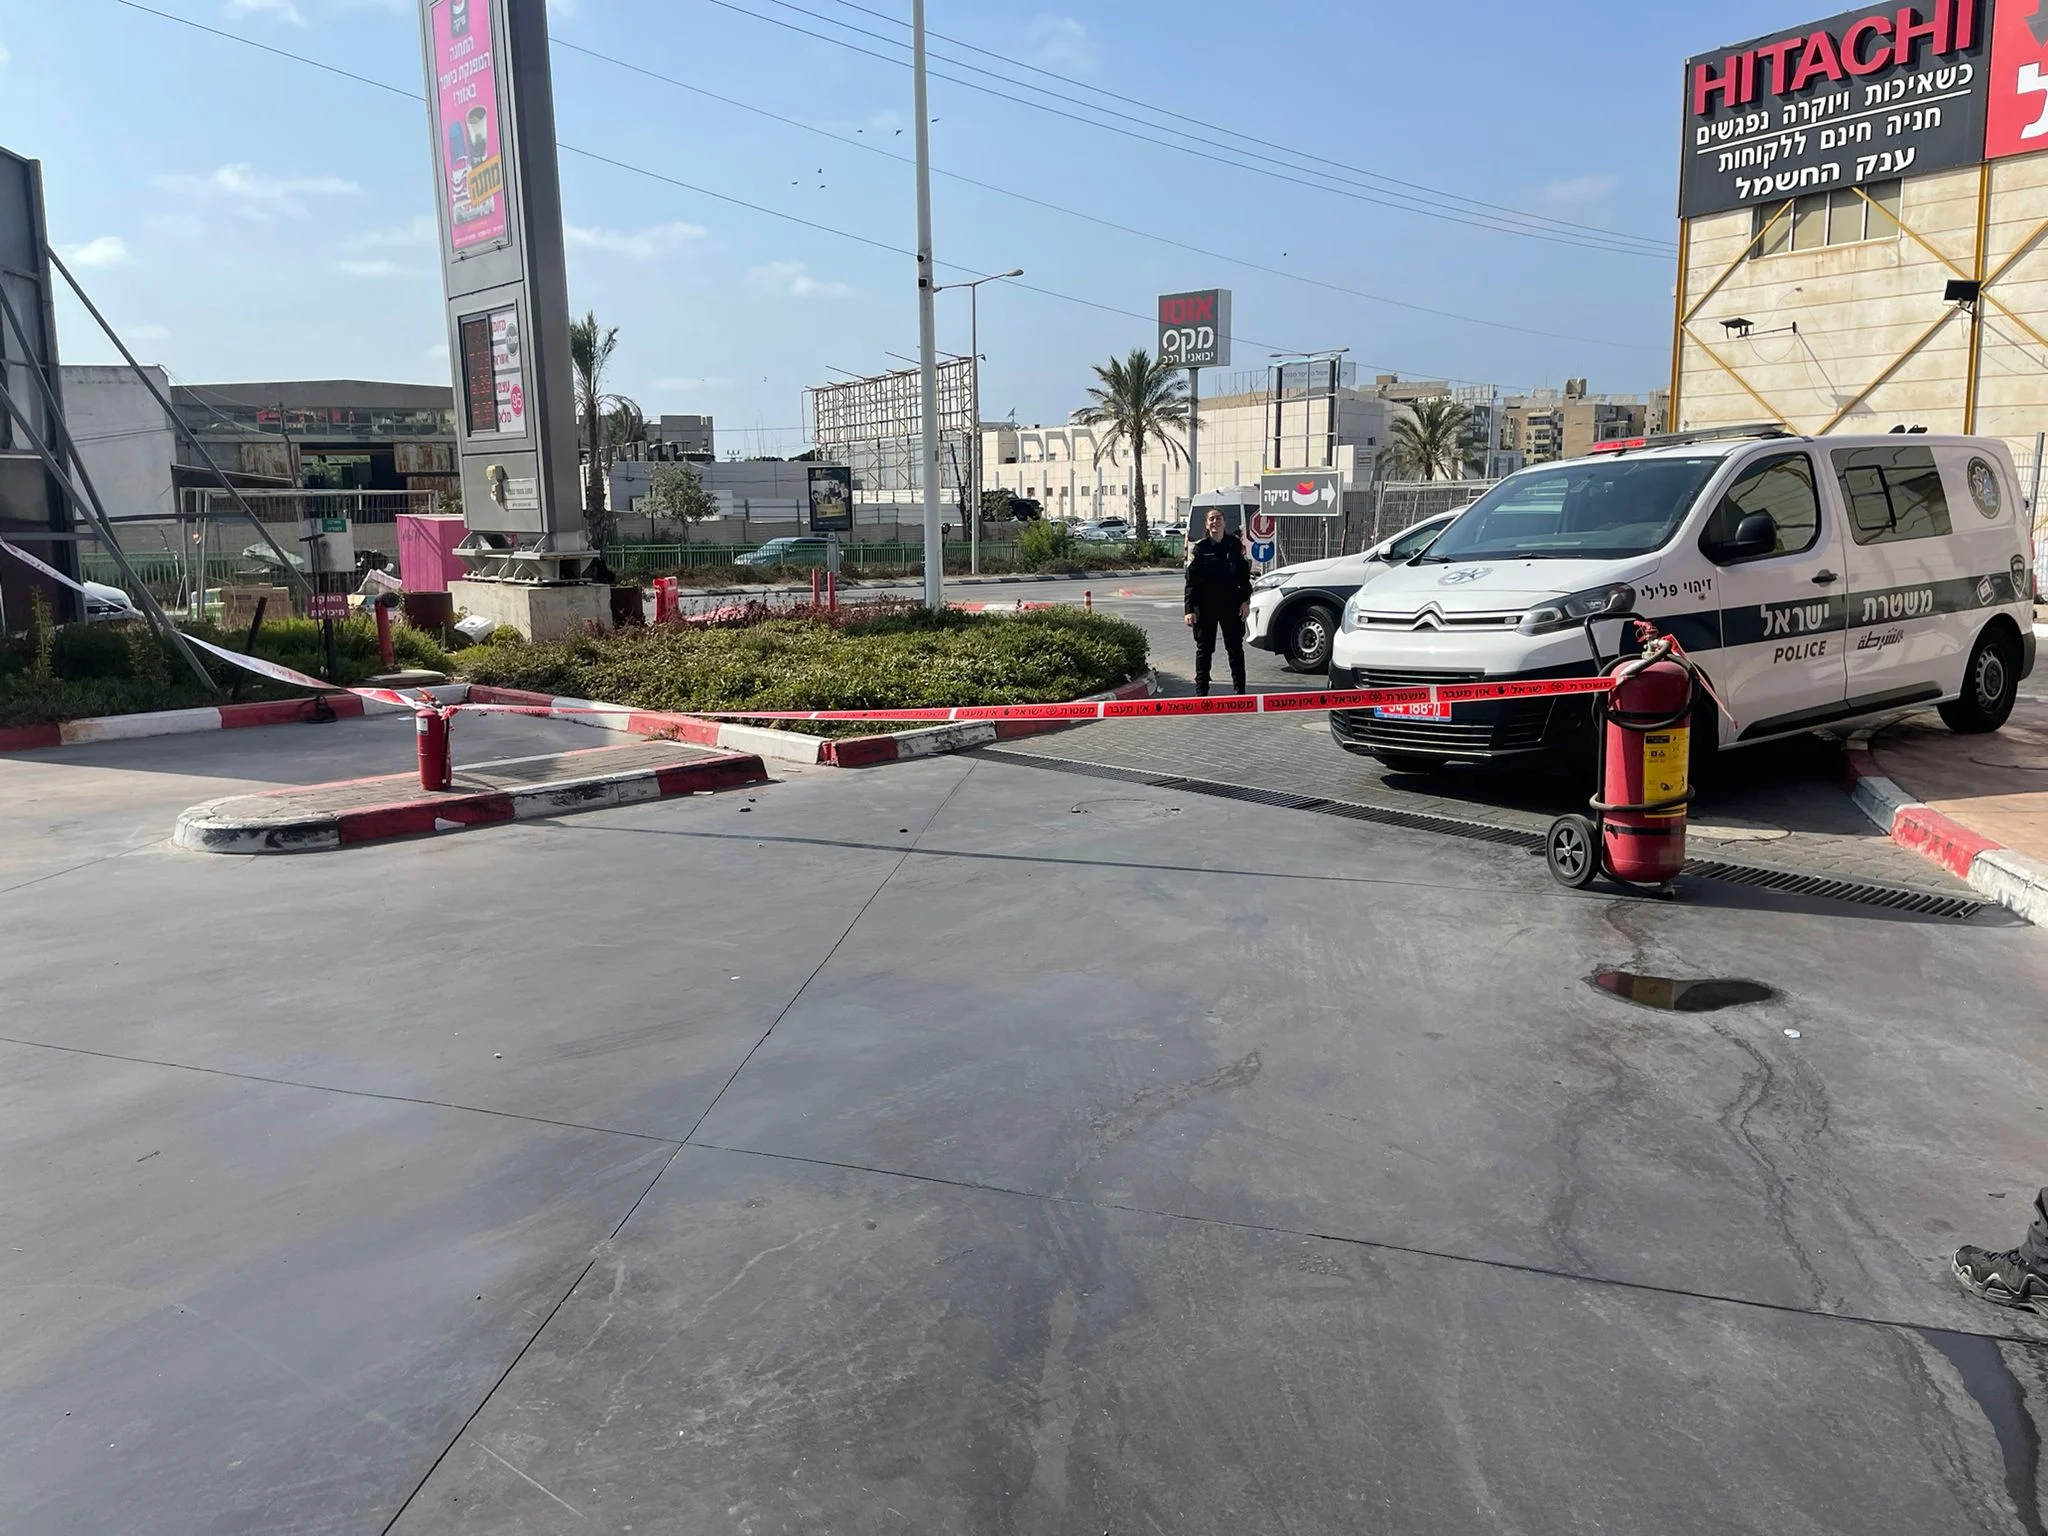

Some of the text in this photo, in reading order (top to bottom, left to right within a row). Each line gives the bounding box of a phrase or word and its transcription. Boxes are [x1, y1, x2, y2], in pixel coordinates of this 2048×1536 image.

[1694, 0, 1974, 116] HITACHI
[1696, 63, 1974, 146] כשאיכות ויוקרה נפגשים
[1718, 106, 1942, 173] חניה חינם ללקוחות
[1735, 146, 1916, 200] ענק החשמל
[1162, 292, 1215, 326] אוטו
[1162, 326, 1215, 363] מקס
[1187, 351, 1214, 362] יבואני
[511, 392, 522, 409] 95
[1263, 489, 1290, 507] מיקה
[1640, 577, 1712, 601] זיהוי פלילי
[1760, 588, 1934, 637] משטרת ישראל
[1857, 627, 1904, 651] الشرطة
[1773, 640, 1827, 664] POLICE
[1270, 691, 1427, 708] משטרת ישראל אין מעבר
[1442, 681, 1613, 699] משטרת ישראל אין מעבר
[985, 709, 998, 717] אין
[1015, 708, 1042, 716] ישראל
[1060, 706, 1095, 715] משטרת
[1109, 701, 1254, 716] משטרת ישראל אין מעבר
